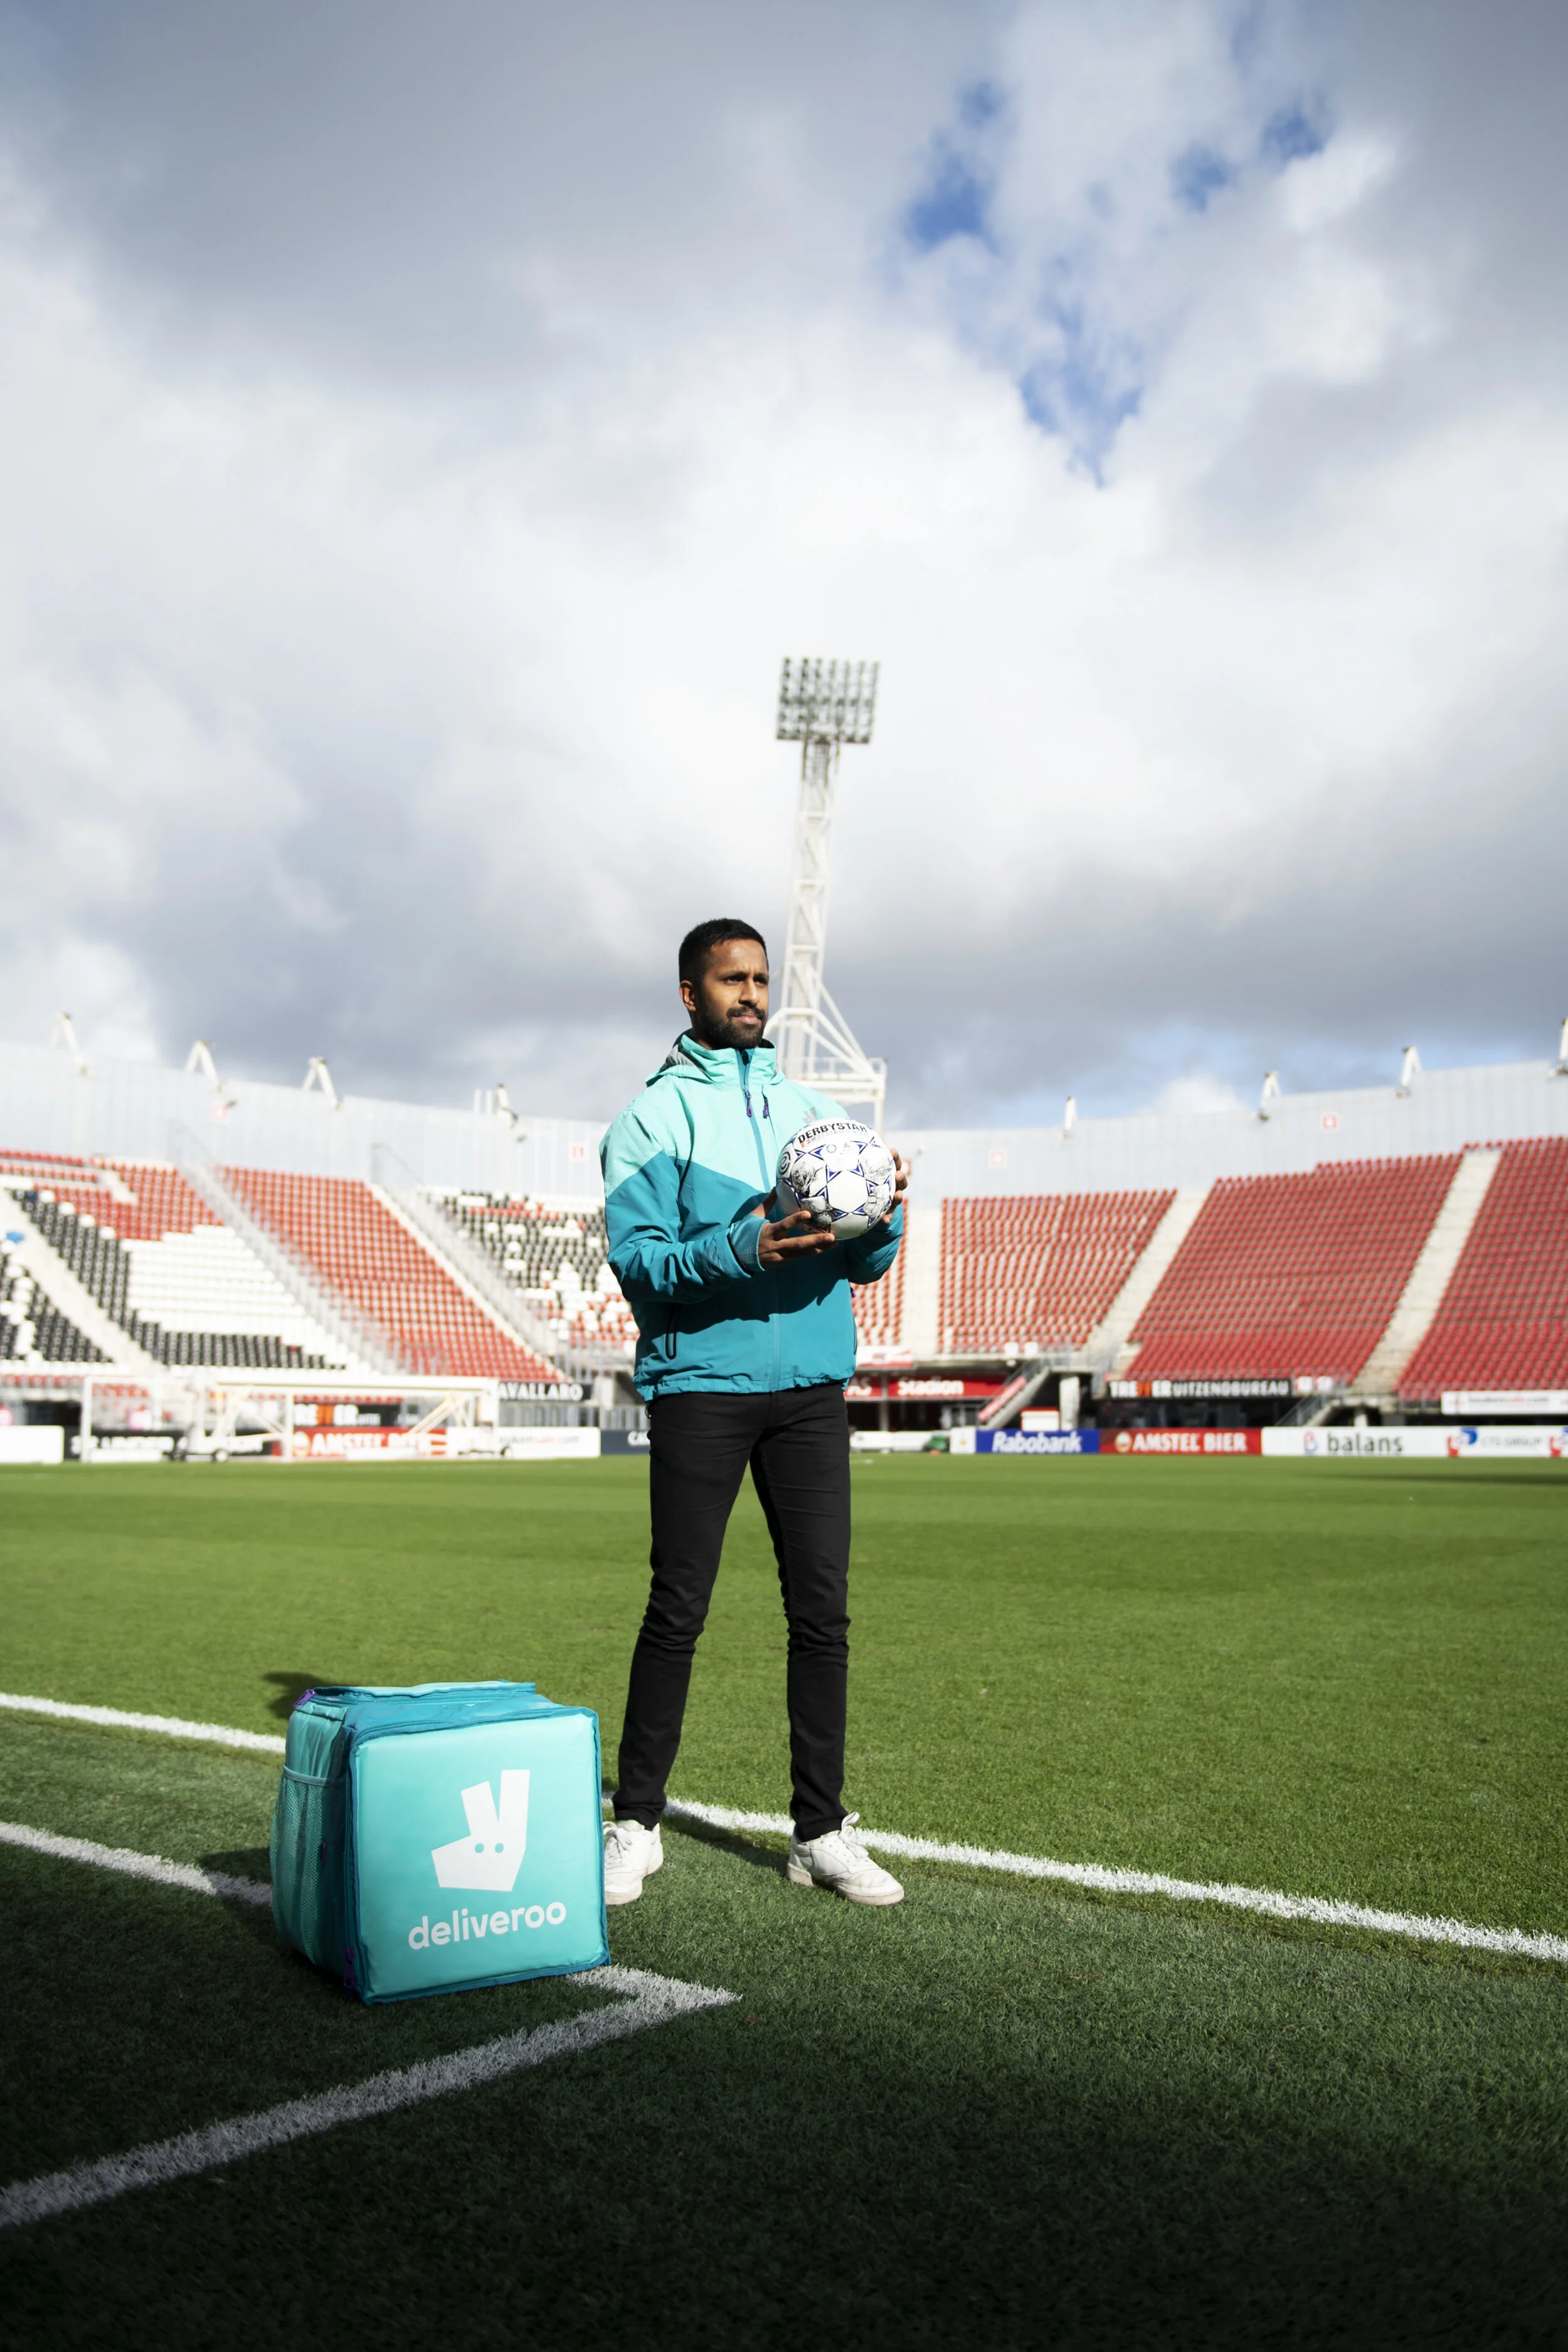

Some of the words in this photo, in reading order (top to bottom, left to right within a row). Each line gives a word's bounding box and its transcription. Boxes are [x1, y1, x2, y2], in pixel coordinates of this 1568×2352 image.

[798, 1122, 868, 1143] DERBYSTAR
[499, 1382, 583, 1400] AVALLARO
[897, 1376, 964, 1396] Stadion
[1172, 1380, 1290, 1397] UITZENDBUREAU
[992, 1430, 1083, 1453] Rabobank
[1133, 1433, 1200, 1452] AMSTEL
[1203, 1432, 1248, 1452] BIER
[1327, 1433, 1404, 1452] balans
[408, 1902, 566, 1950] deliveroo
